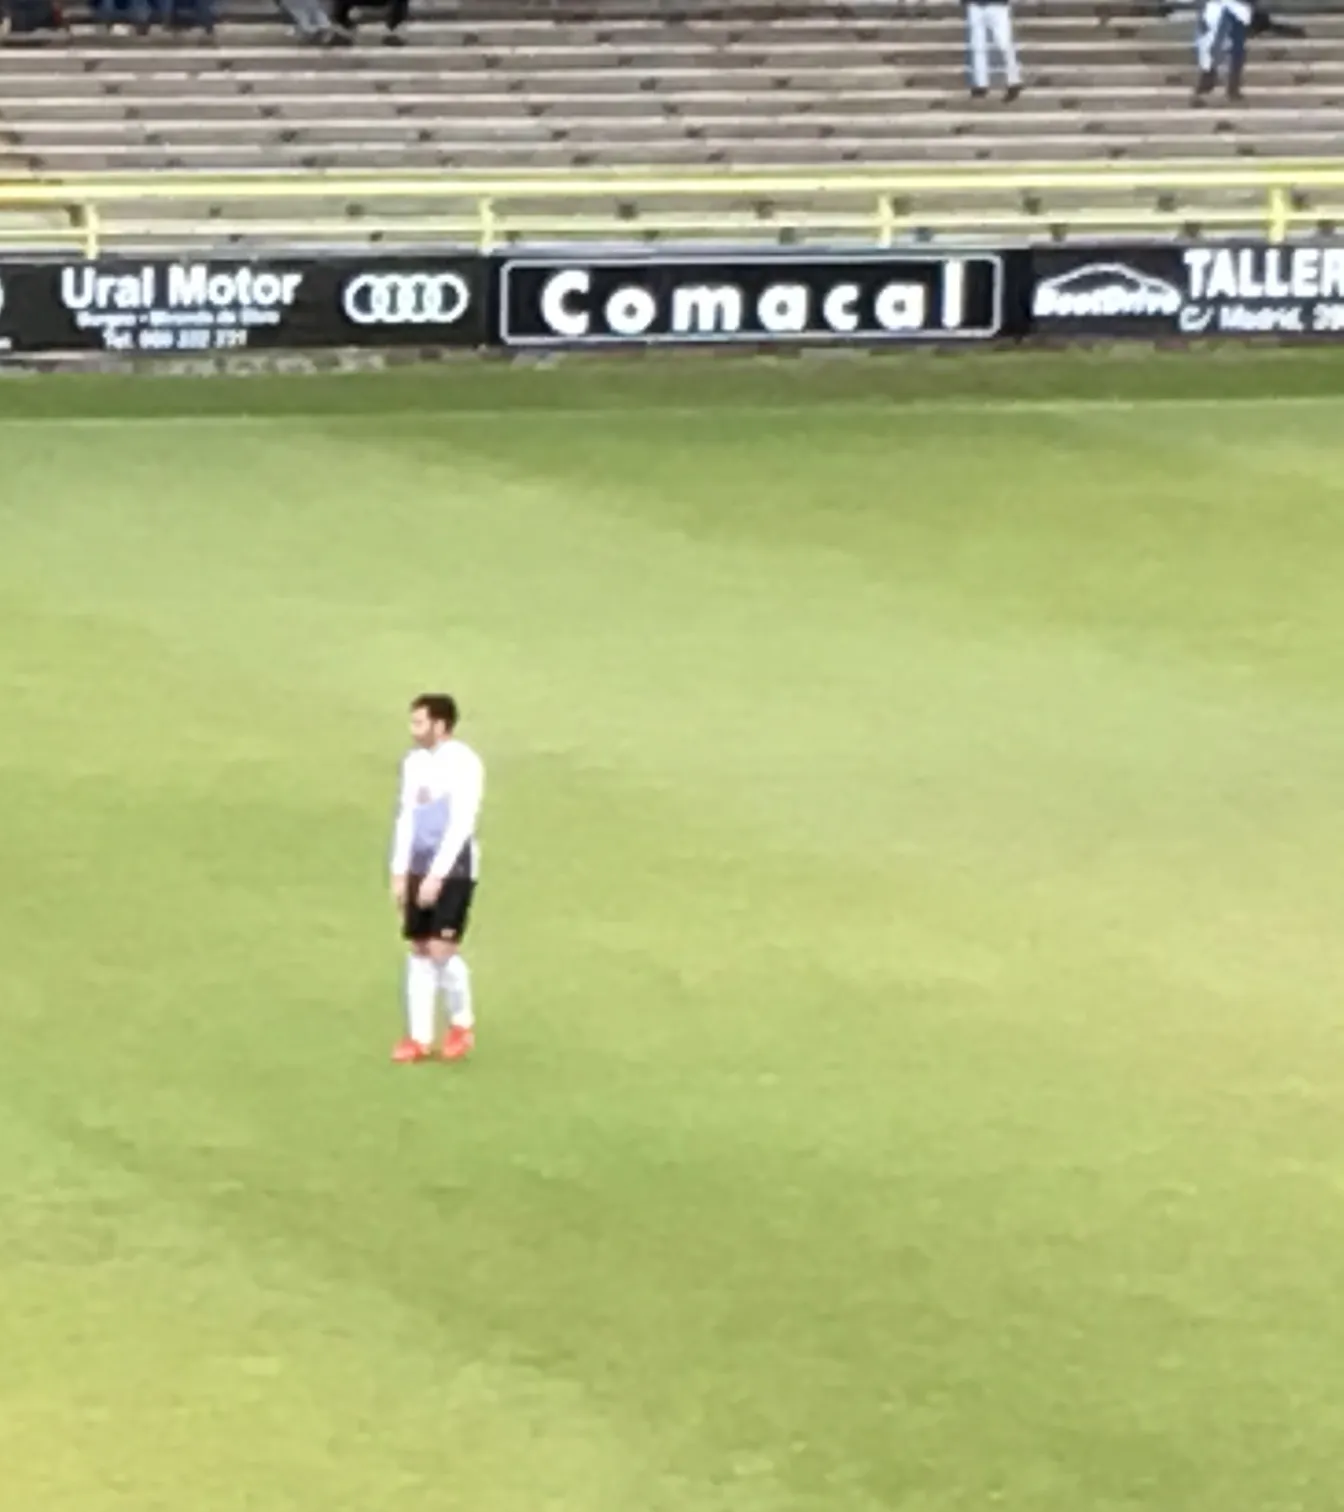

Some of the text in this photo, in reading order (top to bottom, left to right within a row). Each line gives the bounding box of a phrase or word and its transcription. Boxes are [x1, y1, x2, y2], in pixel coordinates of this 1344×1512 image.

[62, 264, 302, 308] Ural Motor
[540, 260, 965, 336] Comacal
